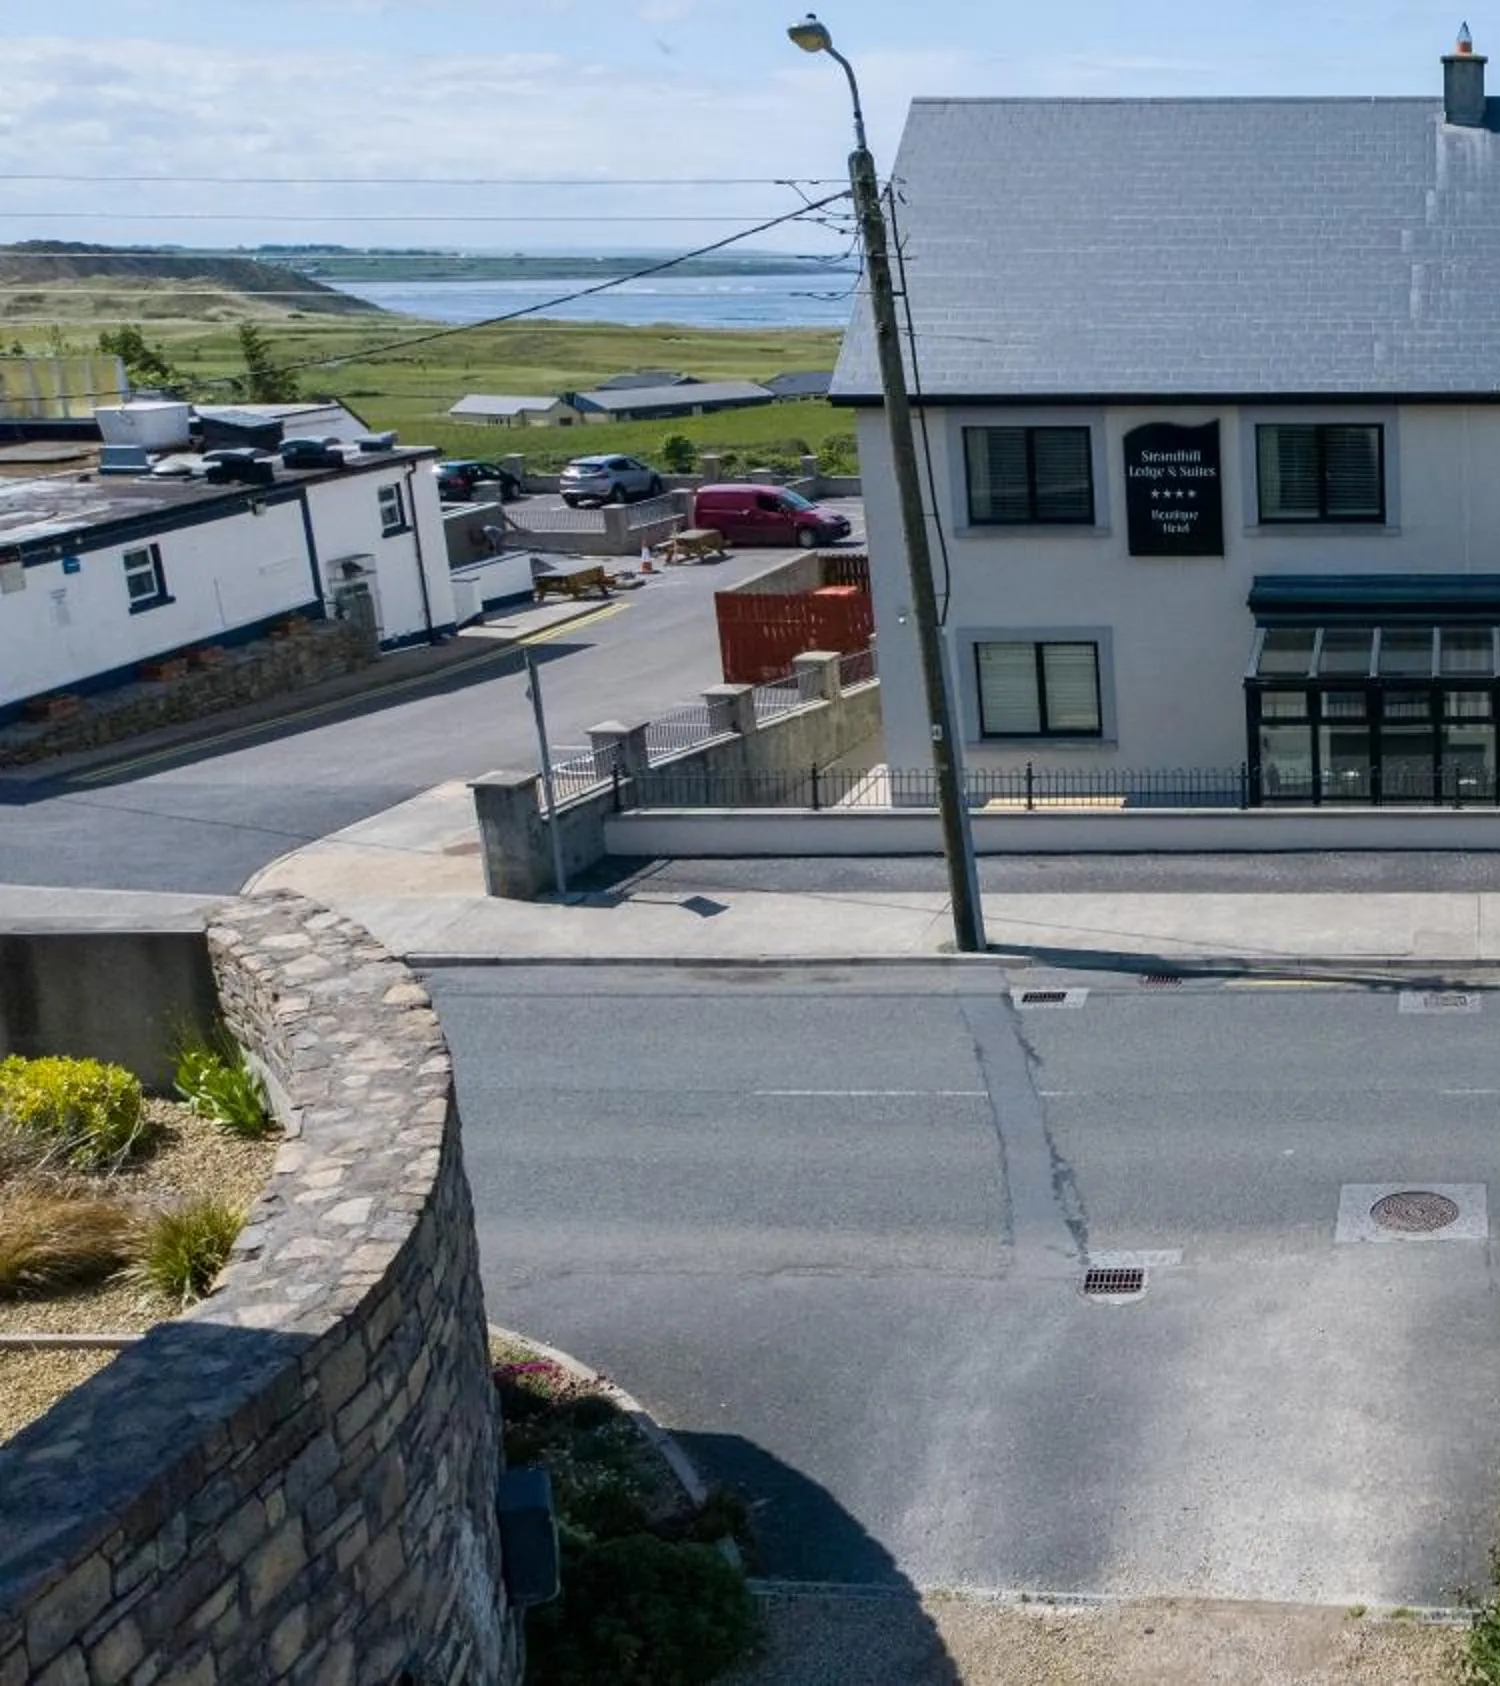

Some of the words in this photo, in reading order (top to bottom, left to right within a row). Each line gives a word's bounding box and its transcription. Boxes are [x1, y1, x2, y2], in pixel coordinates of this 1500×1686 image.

[1141, 450, 1201, 463] Strandhill
[1129, 465, 1165, 479] Lodge
[1168, 466, 1177, 477] &
[1179, 466, 1217, 477] Suites
